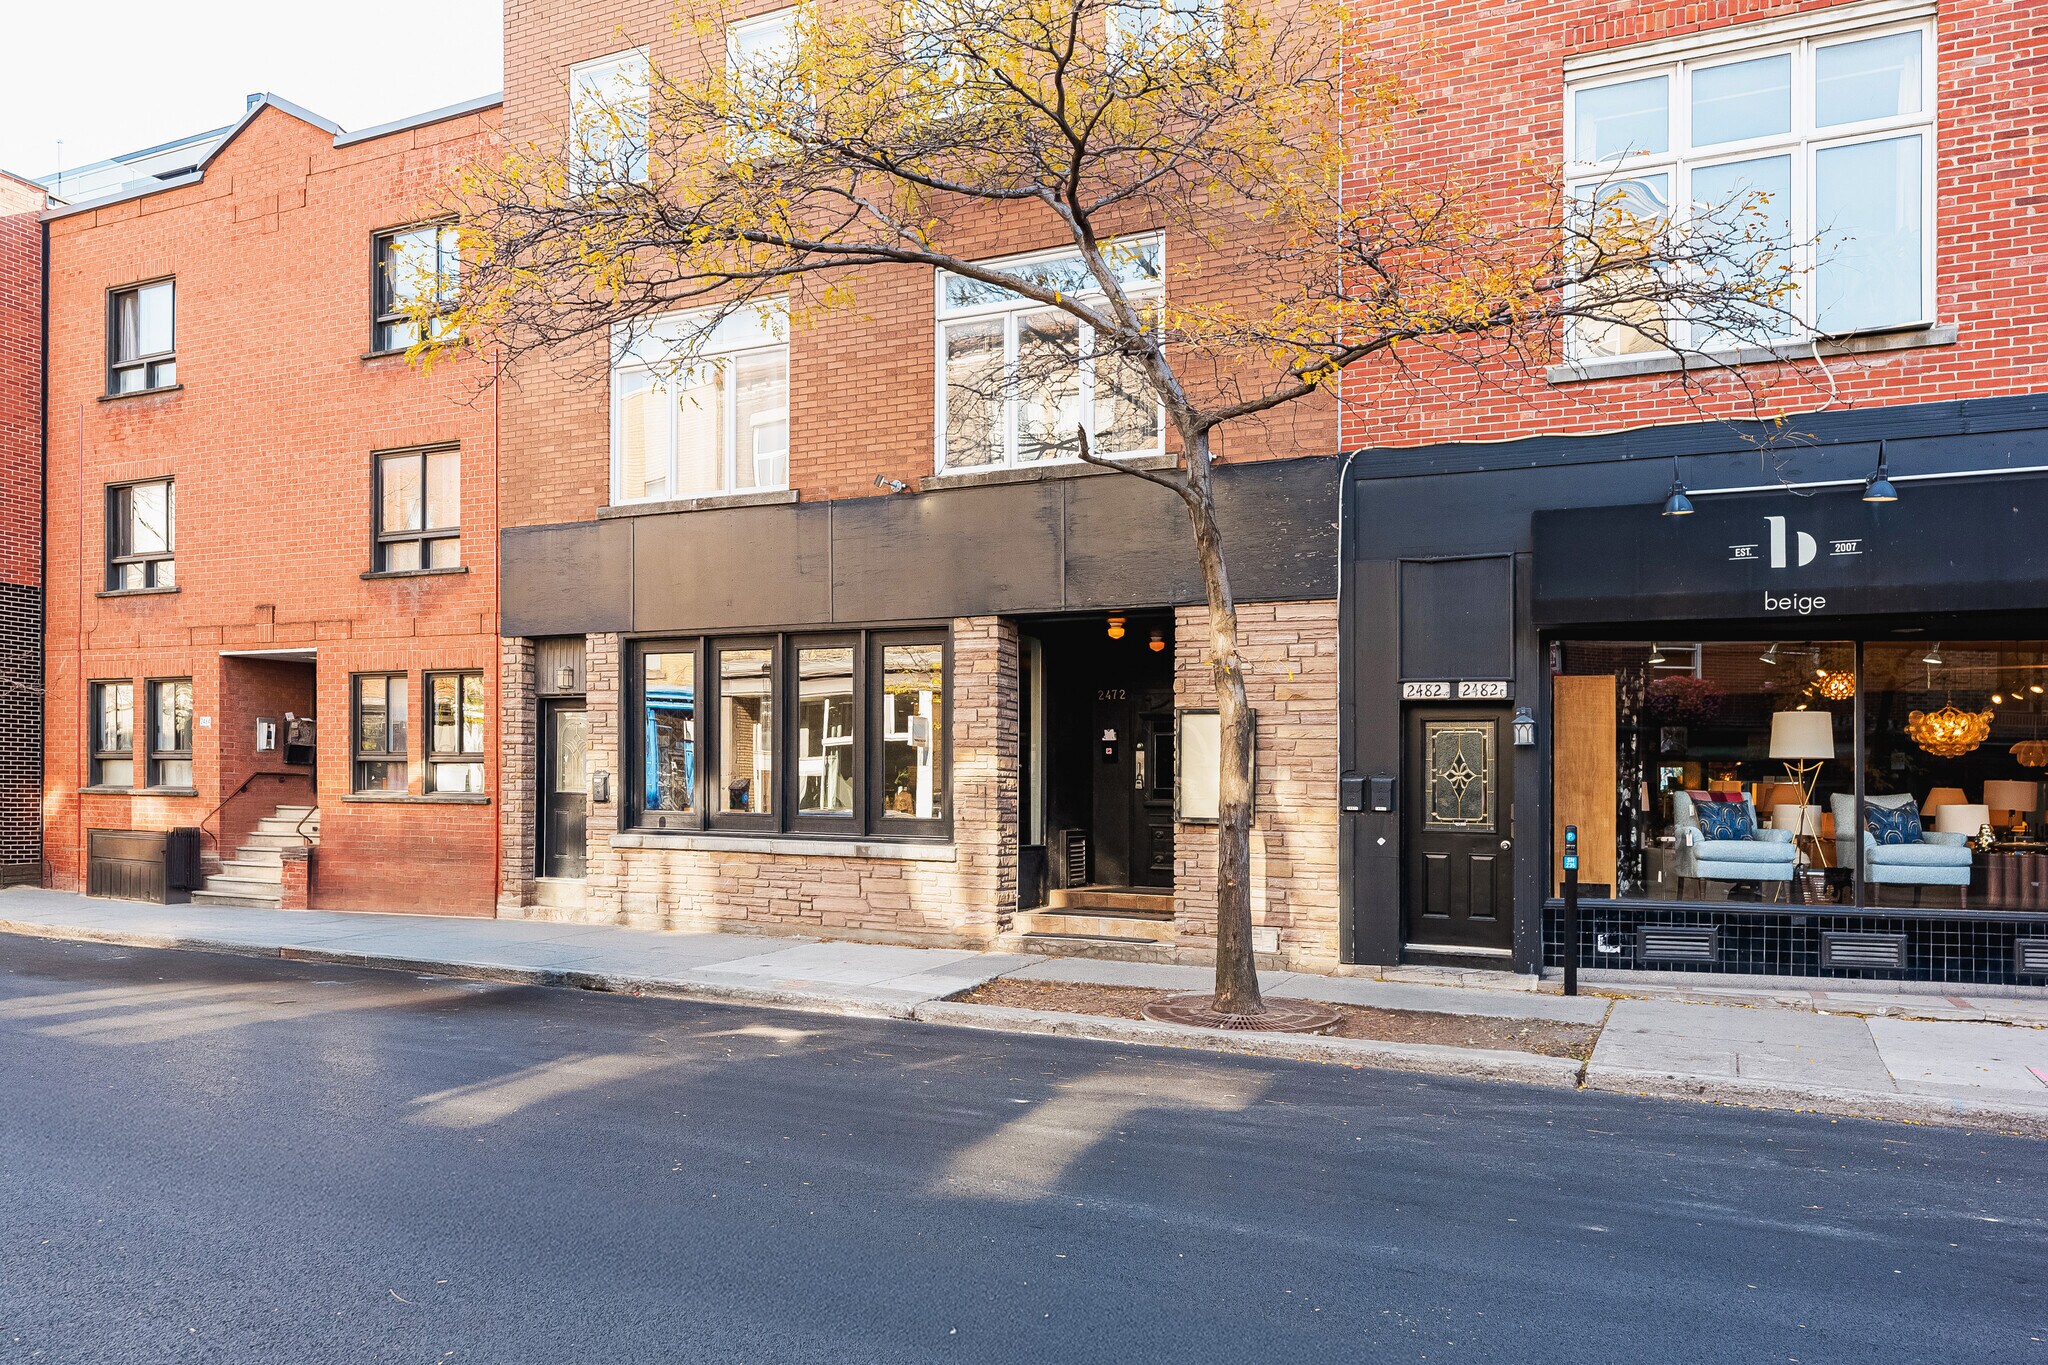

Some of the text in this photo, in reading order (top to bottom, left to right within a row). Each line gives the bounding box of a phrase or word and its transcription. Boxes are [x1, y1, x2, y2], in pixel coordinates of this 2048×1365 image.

[1735, 547, 1752, 557] EST.
[1835, 542, 1857, 553] 2007
[1764, 590, 1826, 615] beige
[1097, 689, 1126, 700] 2472
